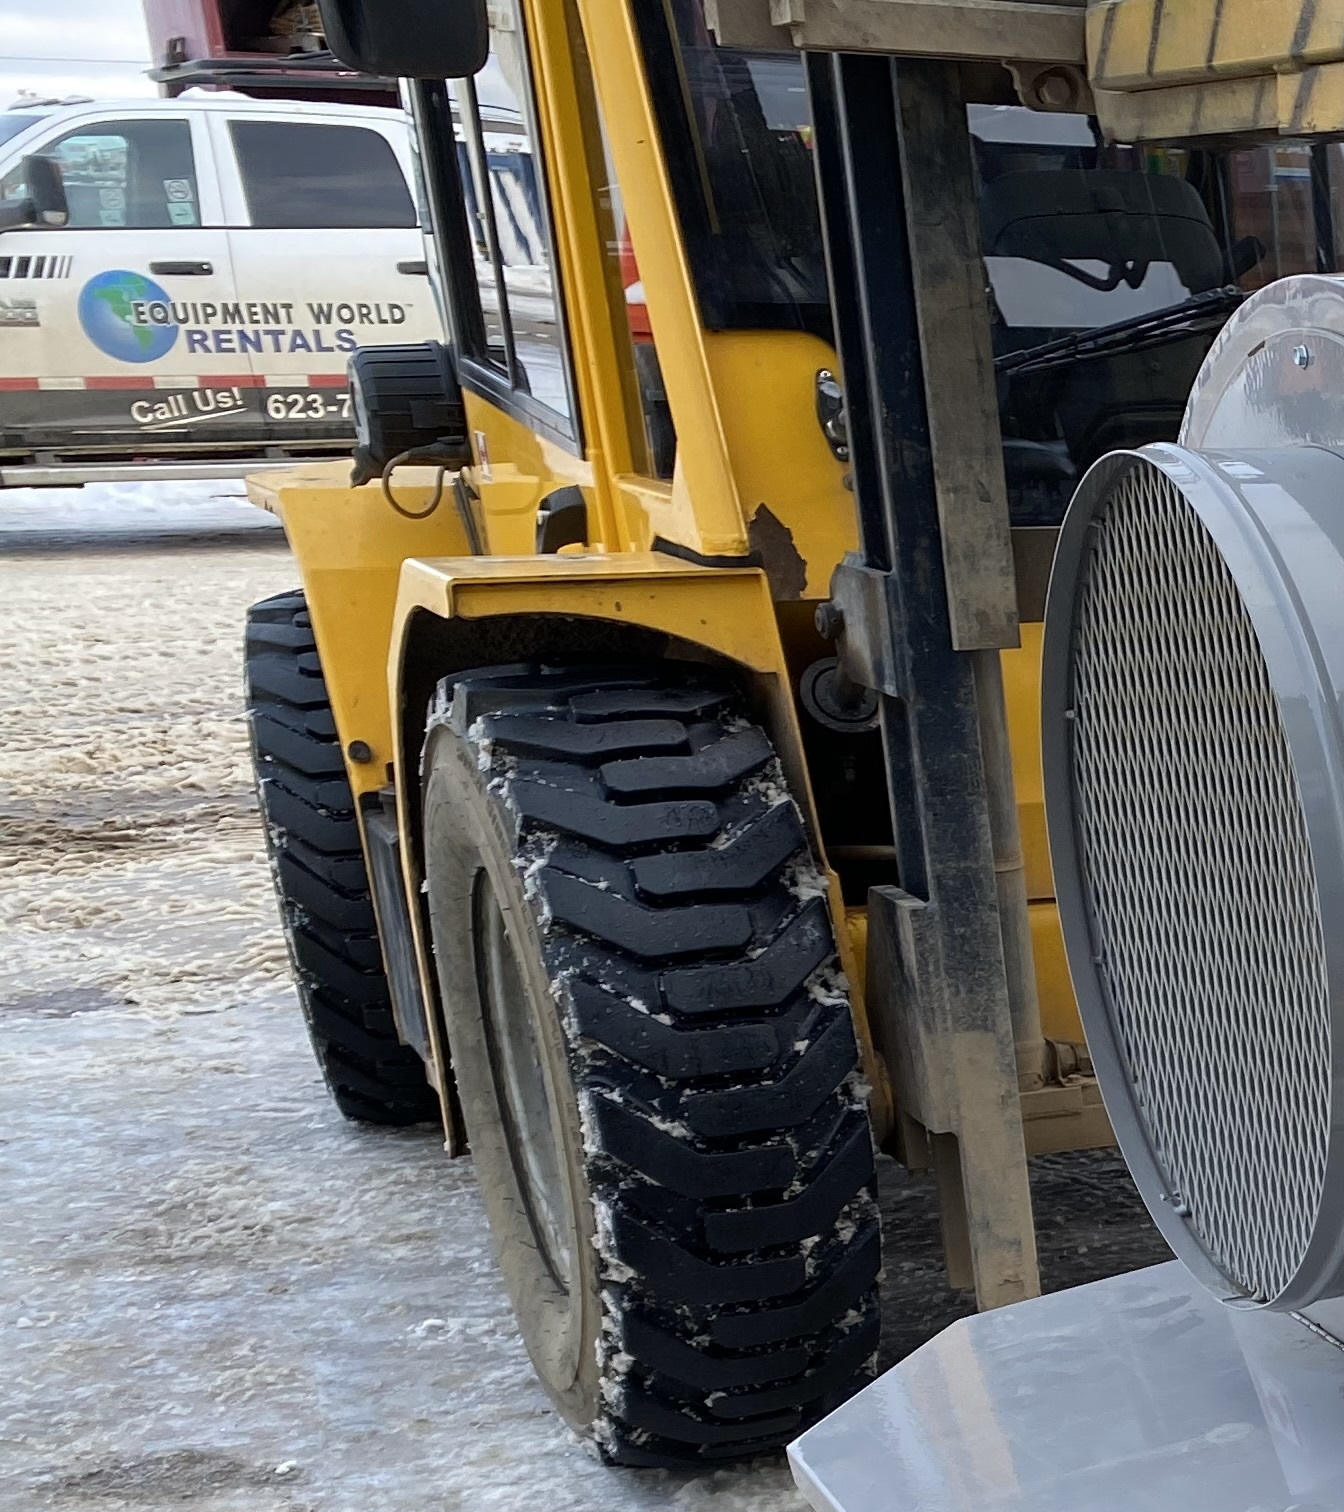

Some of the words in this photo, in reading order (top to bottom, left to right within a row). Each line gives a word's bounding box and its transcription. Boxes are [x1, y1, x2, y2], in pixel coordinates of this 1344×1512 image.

[131, 302, 294, 326] EQUIPMENT
[307, 303, 406, 325] WORLD
[185, 328, 357, 353] RENTALS
[131, 395, 188, 424] Call
[192, 387, 244, 412] Us!
